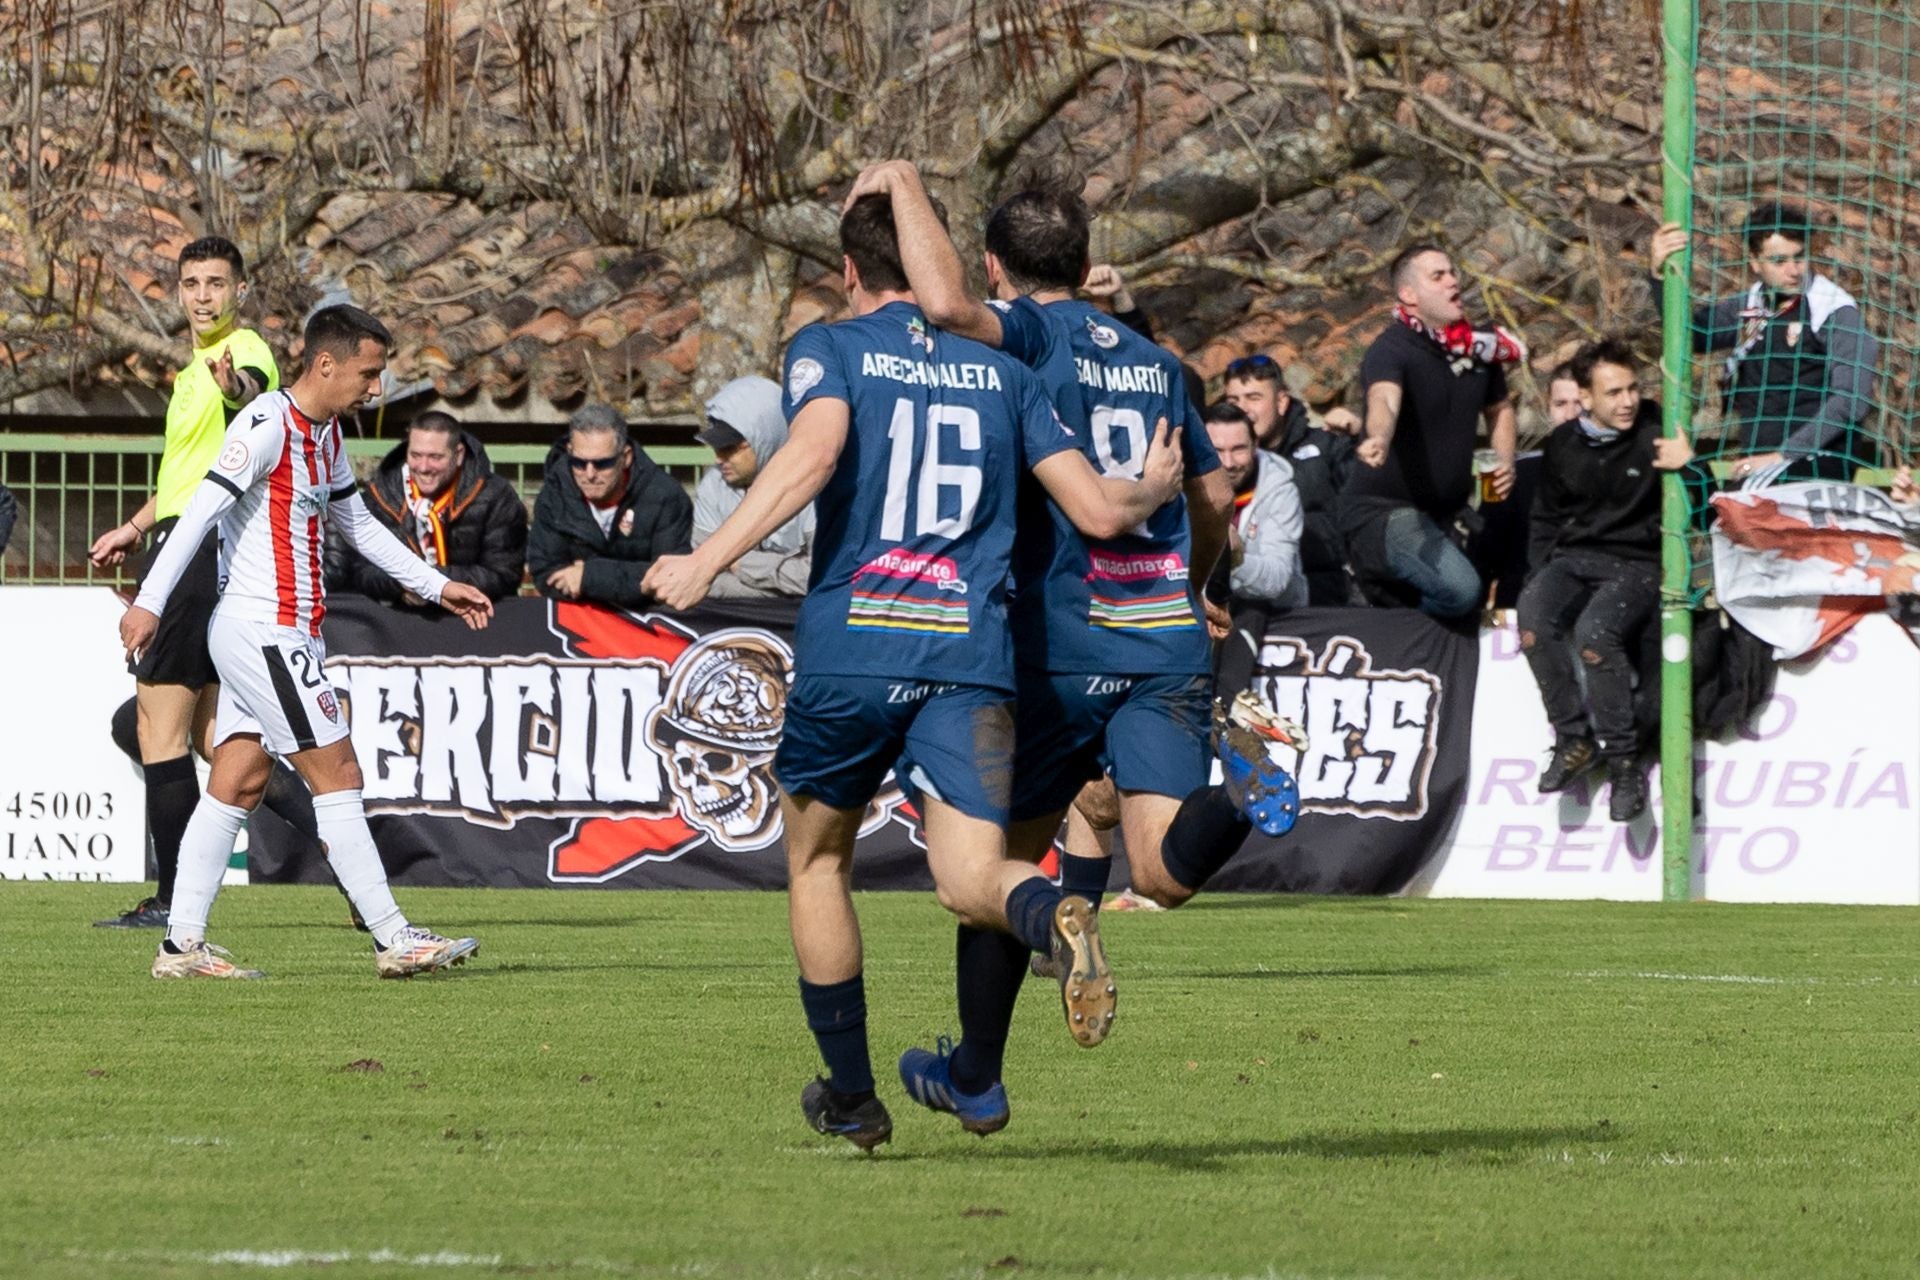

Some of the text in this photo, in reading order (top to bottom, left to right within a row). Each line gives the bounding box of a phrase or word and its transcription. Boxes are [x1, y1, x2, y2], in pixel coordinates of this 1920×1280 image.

[862, 352, 1002, 391] ARECHVALETA
[880, 398, 982, 541] 16
[325, 664, 662, 813] ERCIO
[6, 791, 113, 820] 45003
[8, 832, 113, 861] IANO
[1485, 825, 1800, 875] BENTO
